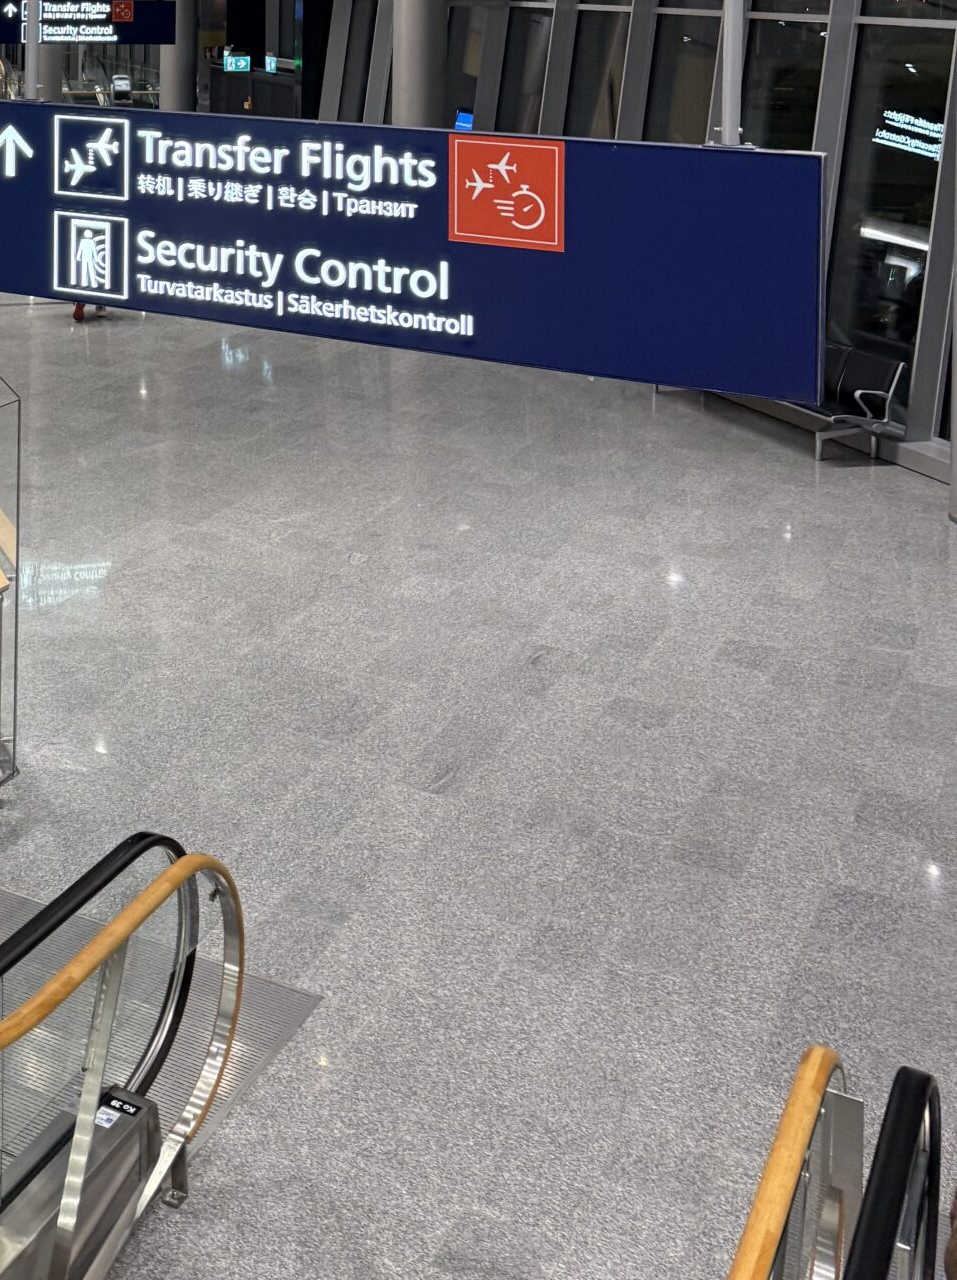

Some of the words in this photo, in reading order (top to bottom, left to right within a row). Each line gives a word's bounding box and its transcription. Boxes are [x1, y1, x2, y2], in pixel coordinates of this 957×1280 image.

[43, 2, 79, 12] Transfer
[81, 2, 111, 14] Flights
[43, 24, 78, 36] Security
[79, 24, 113, 35] Control
[137, 129, 290, 175] Transfer
[300, 140, 437, 192] Flights
[137, 173, 175, 196] 转机
[187, 178, 263, 204] 乗り継ぎ
[277, 185, 318, 210] 환승
[332, 190, 419, 219] Транзит
[137, 230, 283, 288] Security
[294, 248, 449, 300] Control
[136, 273, 274, 309] Turvatarkastus
[287, 292, 474, 337] Säkerhetskontroll
